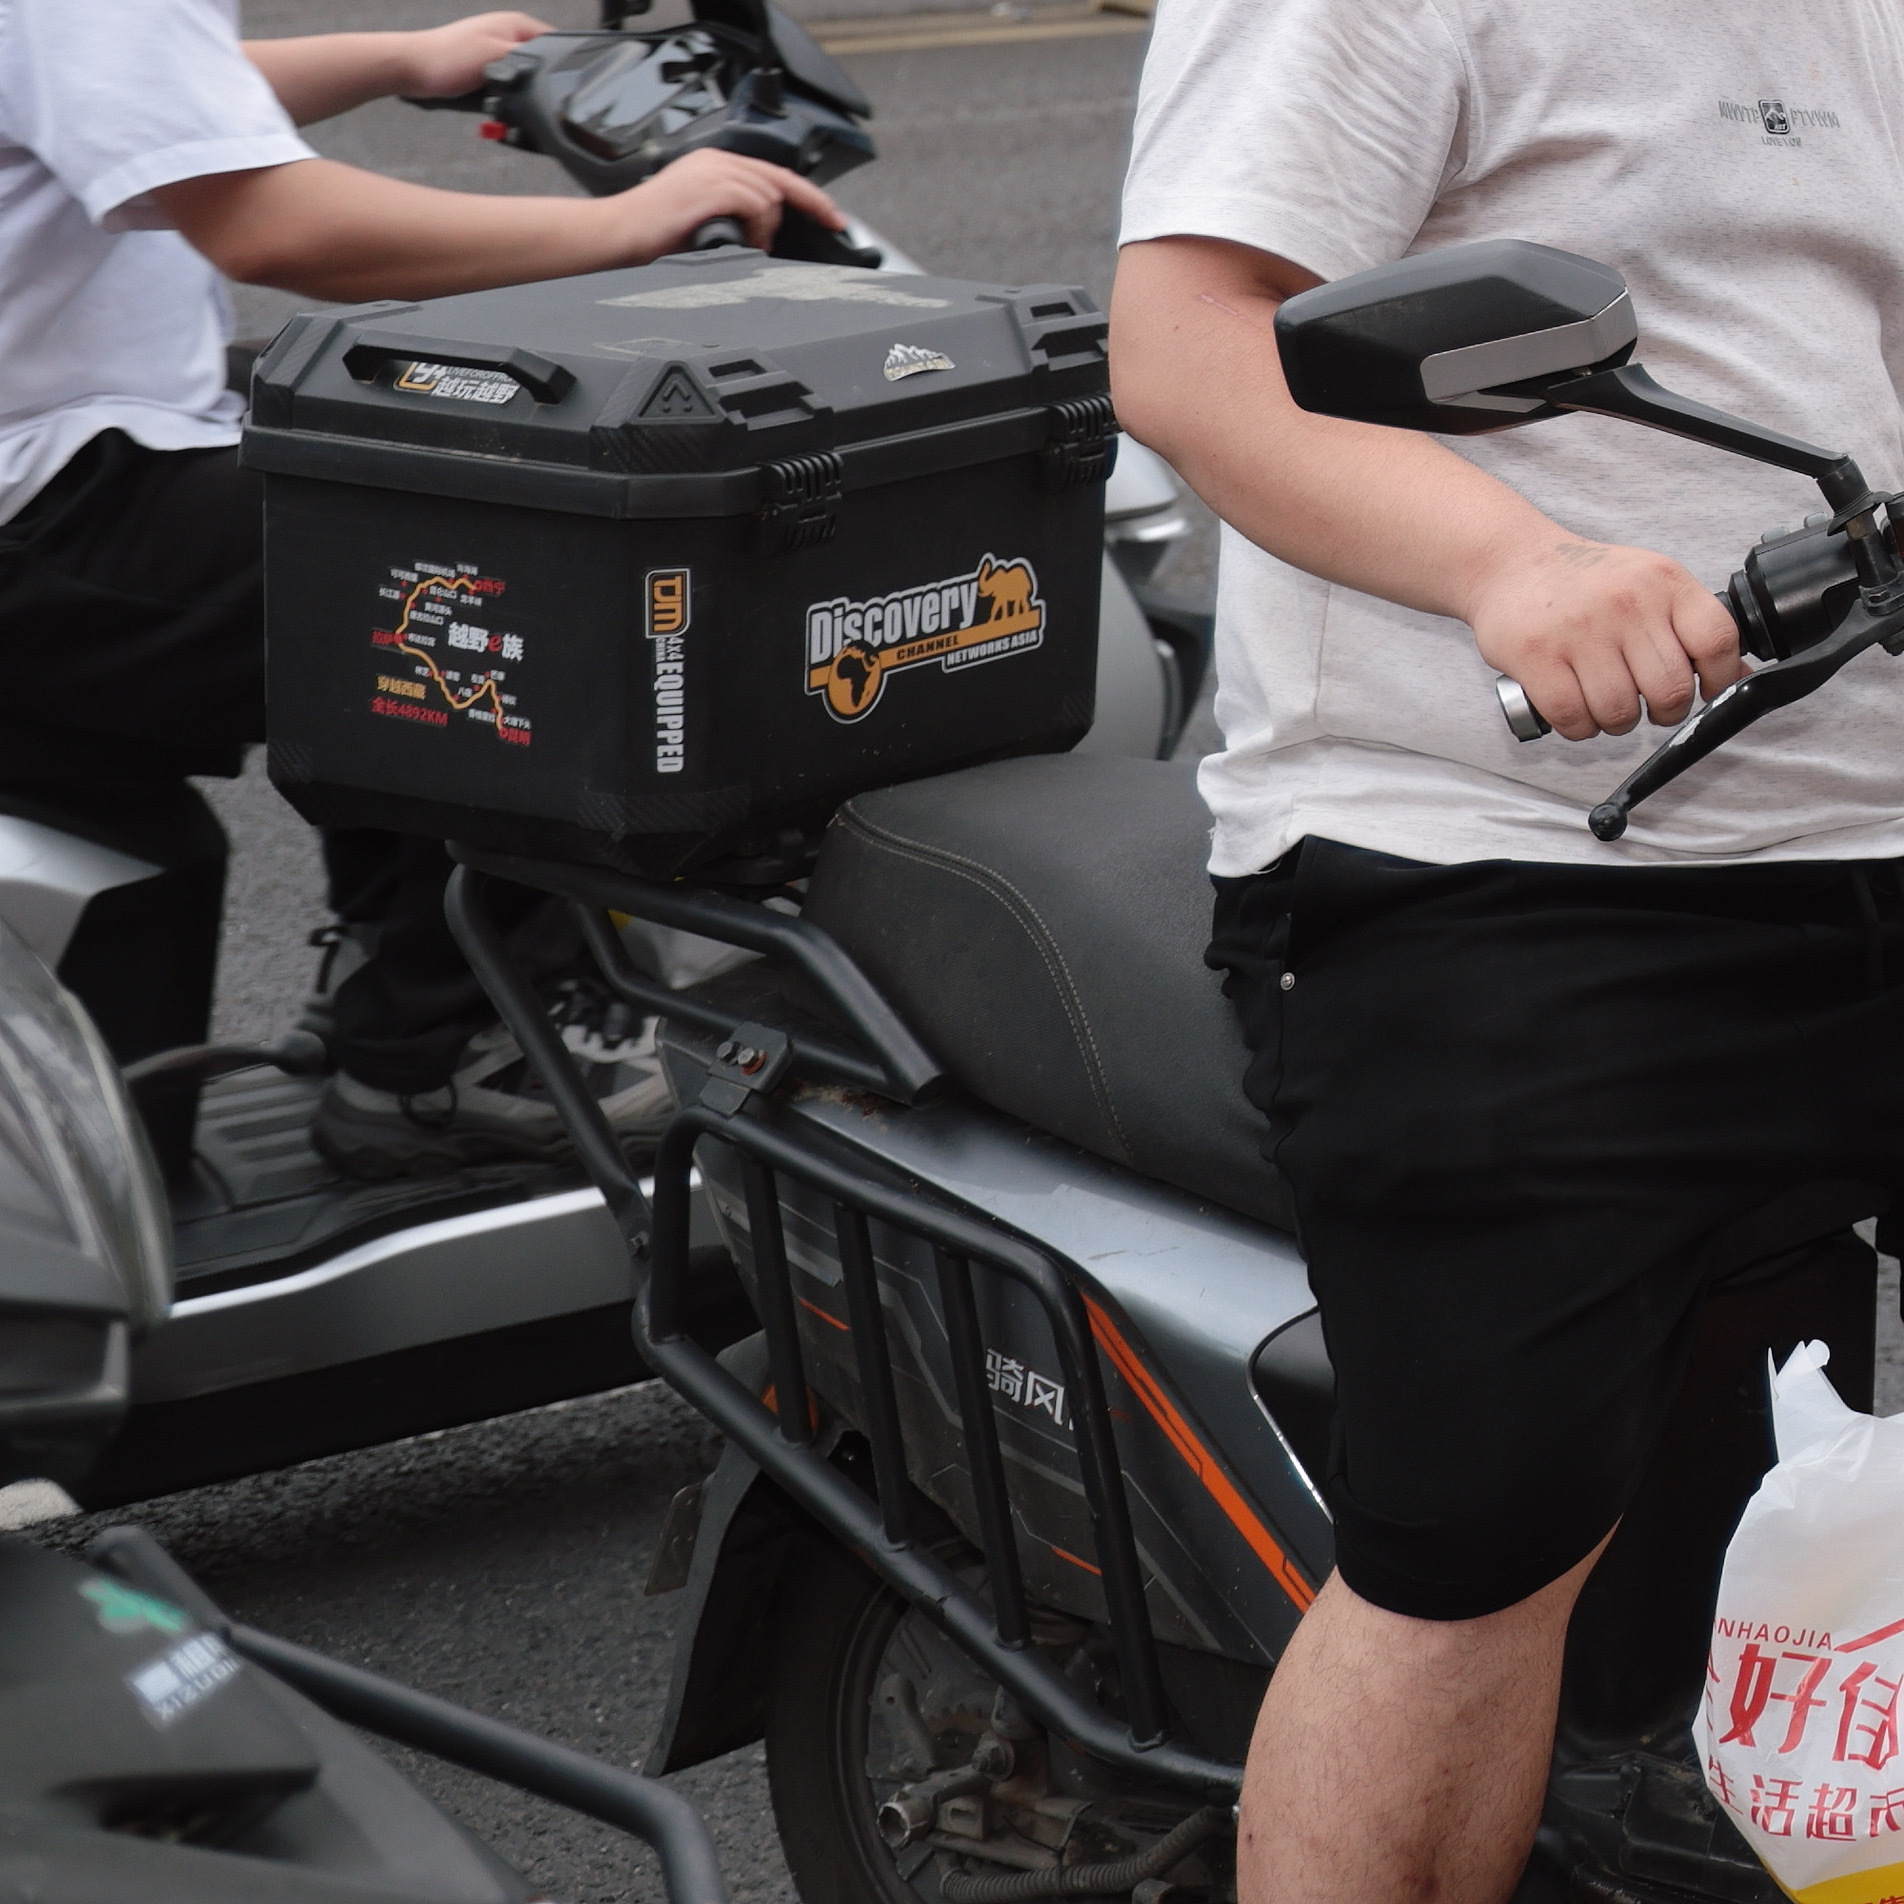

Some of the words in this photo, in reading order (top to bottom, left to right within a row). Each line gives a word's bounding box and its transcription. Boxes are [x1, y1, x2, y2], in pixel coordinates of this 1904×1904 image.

[431, 375, 520, 405] 越玩越野
[448, 621, 524, 662] 越野e族
[810, 580, 979, 665] Discovery
[895, 634, 960, 661] CHANNEL
[946, 637, 1010, 666] NETWORKS
[1010, 628, 1038, 649] ASIA
[377, 675, 427, 700] 穿越西藏
[653, 661, 685, 773] EQUIPPED
[985, 1347, 1074, 1432] 骑风
[1711, 1618, 1833, 1651] NHAOJIA
